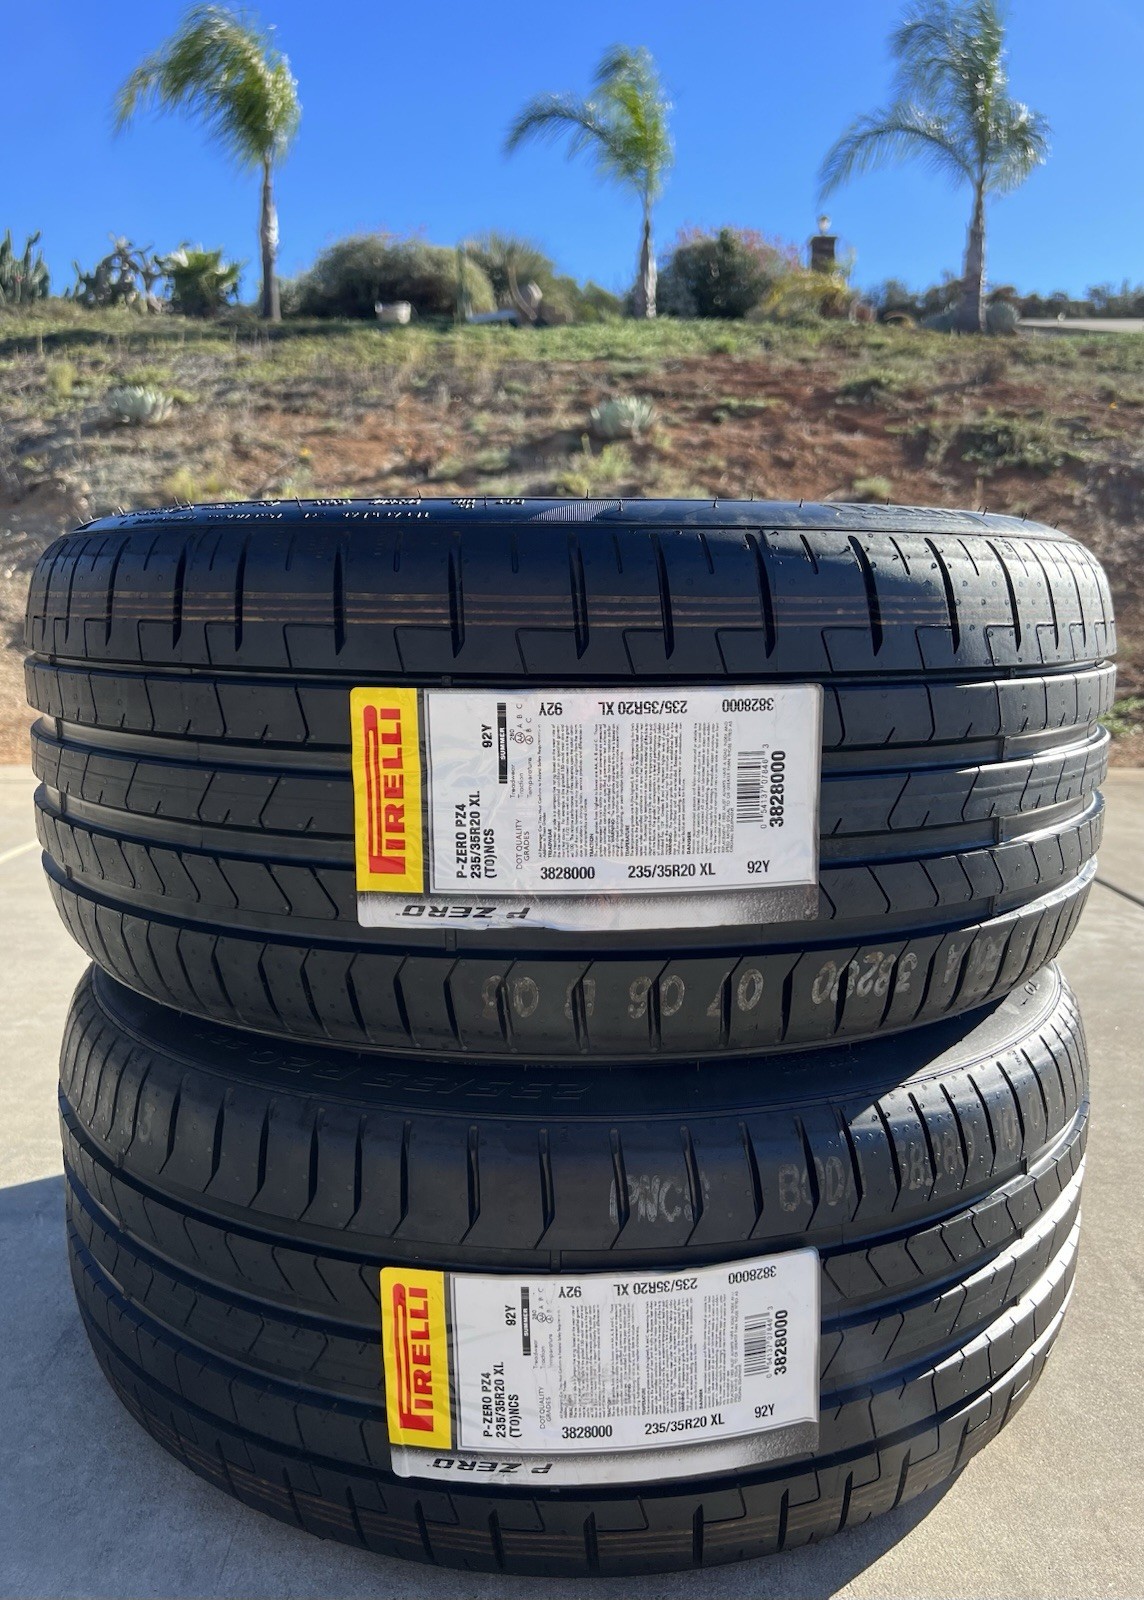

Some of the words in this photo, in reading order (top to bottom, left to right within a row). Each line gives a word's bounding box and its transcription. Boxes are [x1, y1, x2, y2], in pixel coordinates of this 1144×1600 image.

[539, 701, 563, 716] 92Y
[598, 702, 616, 715] XL
[617, 699, 688, 715] 235/35R20
[722, 697, 775, 712] 3828000
[481, 723, 493, 748] 92Y
[499, 727, 507, 760] SUMMER
[364, 704, 406, 875] PIRELLI
[516, 772, 524, 798] Traction
[769, 750, 786, 827] 3828000
[469, 790, 481, 807] XL
[455, 803, 467, 828] PZ4
[469, 811, 482, 879] 235/35R20
[515, 819, 523, 852] QUALITY
[456, 832, 468, 878] P-ZERO
[515, 853, 523, 869] DOT
[540, 866, 595, 881] 3828000
[628, 864, 696, 879] 235/35R20
[699, 863, 716, 877] XL
[747, 860, 770, 875] 92Y
[728, 1265, 777, 1284] 3828000
[558, 1285, 582, 1298] 92Y
[613, 1283, 630, 1296] XL
[633, 1277, 698, 1295] 235/35R20
[505, 1305, 517, 1326] 92Y
[522, 1308, 530, 1336] SUMMER
[774, 1310, 788, 1375] 3828000
[392, 1283, 433, 1432] PIRELLI
[493, 1361, 505, 1376] XL
[481, 1372, 492, 1392] PZ4
[494, 1379, 507, 1438] 235/35R20
[538, 1386, 546, 1413] QUALITY
[481, 1396, 493, 1437] P-ZERO
[754, 1404, 775, 1419] 92Y
[561, 1424, 613, 1439] 3828000
[644, 1415, 708, 1435] 235/35R20
[710, 1413, 725, 1427] XL
